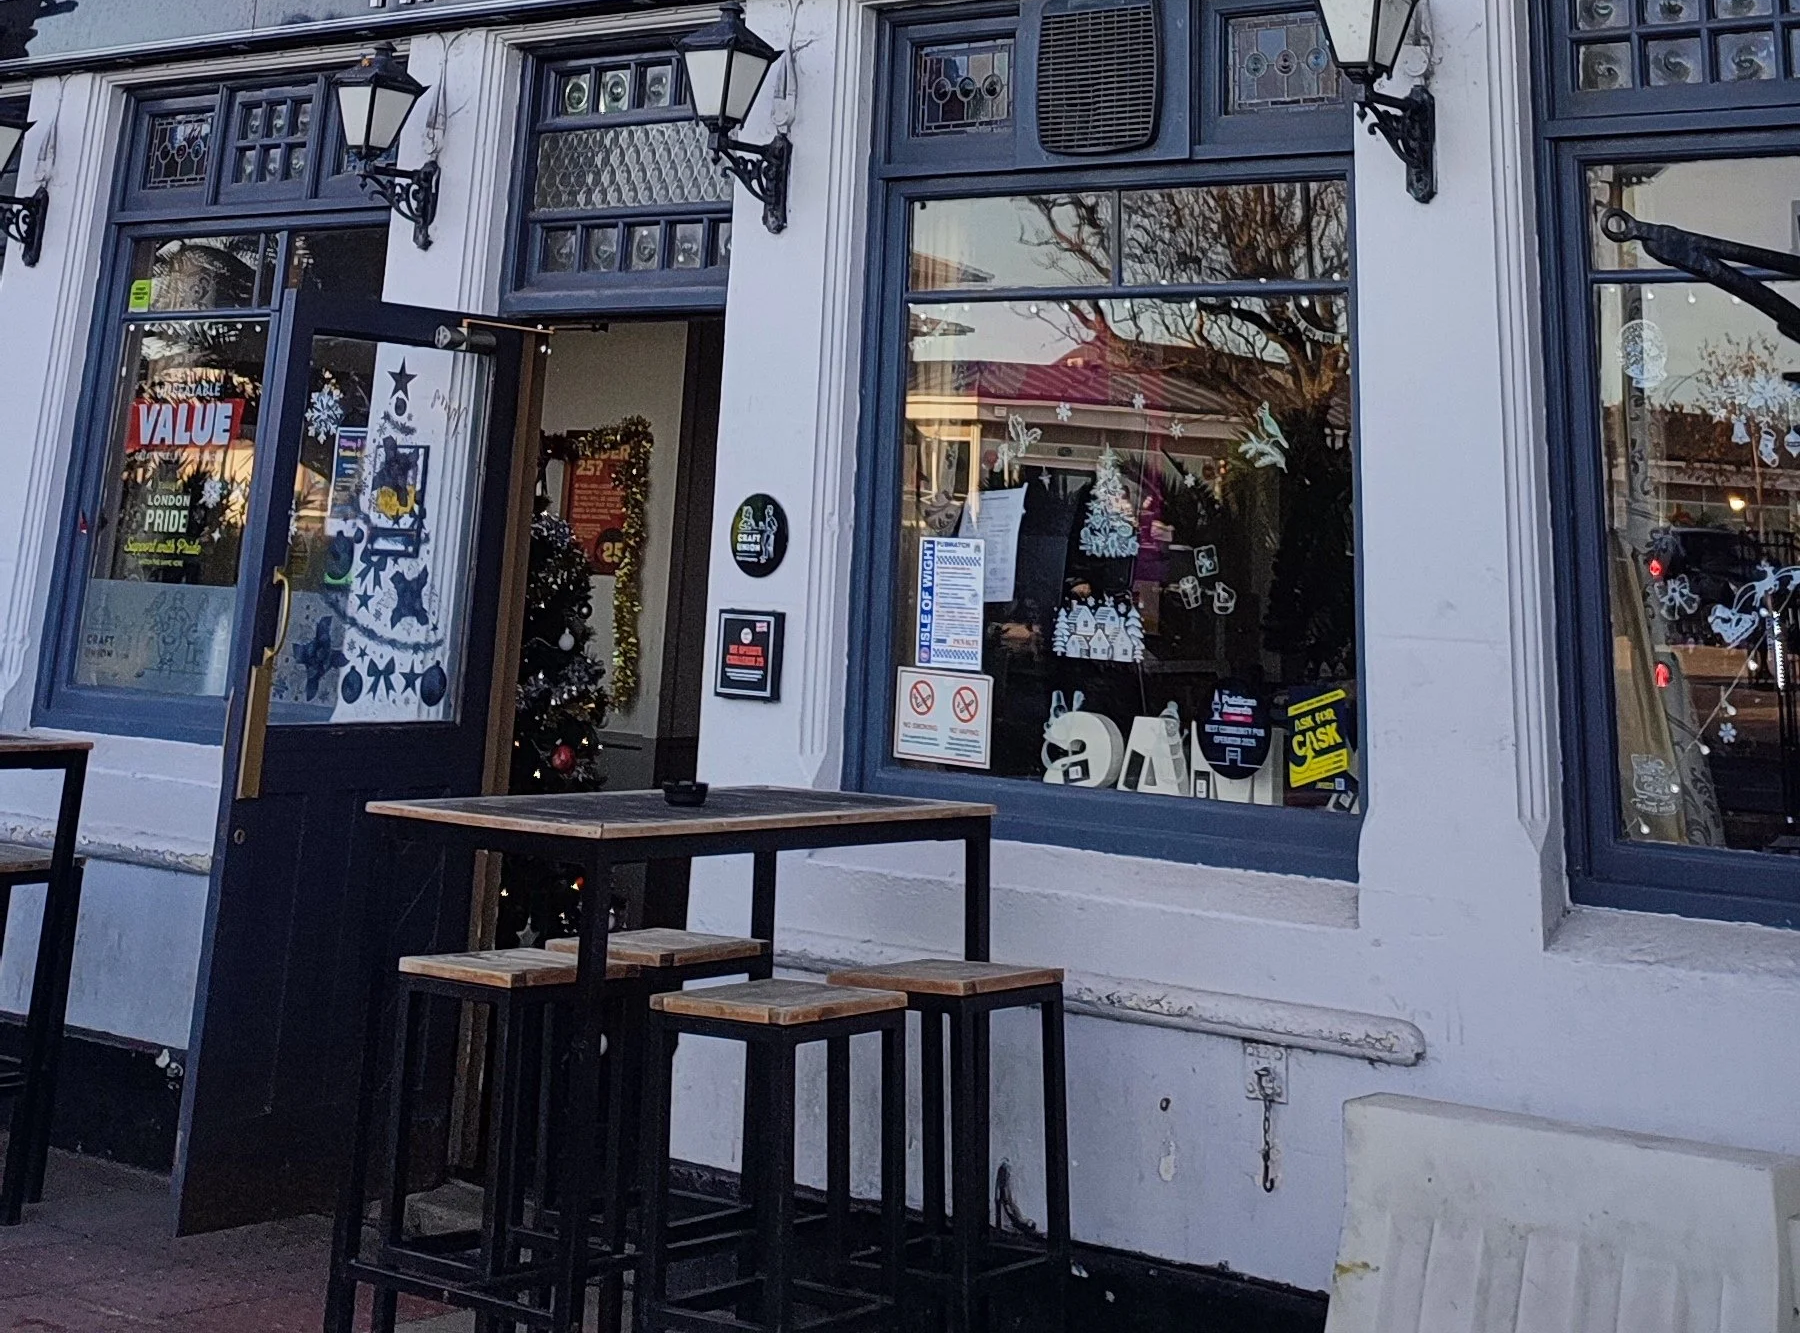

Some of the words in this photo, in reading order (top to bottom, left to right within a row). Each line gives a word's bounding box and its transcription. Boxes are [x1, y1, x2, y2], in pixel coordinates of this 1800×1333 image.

[138, 402, 233, 447] VALUE
[576, 459, 604, 475] 25?
[147, 494, 191, 507] LONDON
[143, 509, 190, 533] PRIDE
[737, 533, 761, 542] CRAFT
[602, 541, 624, 563] 25
[922, 541, 935, 588] WIGHT
[921, 590, 933, 611] OF
[920, 614, 932, 646] ISLE
[1294, 714, 1315, 732] ASK
[1292, 722, 1343, 757] CASK
